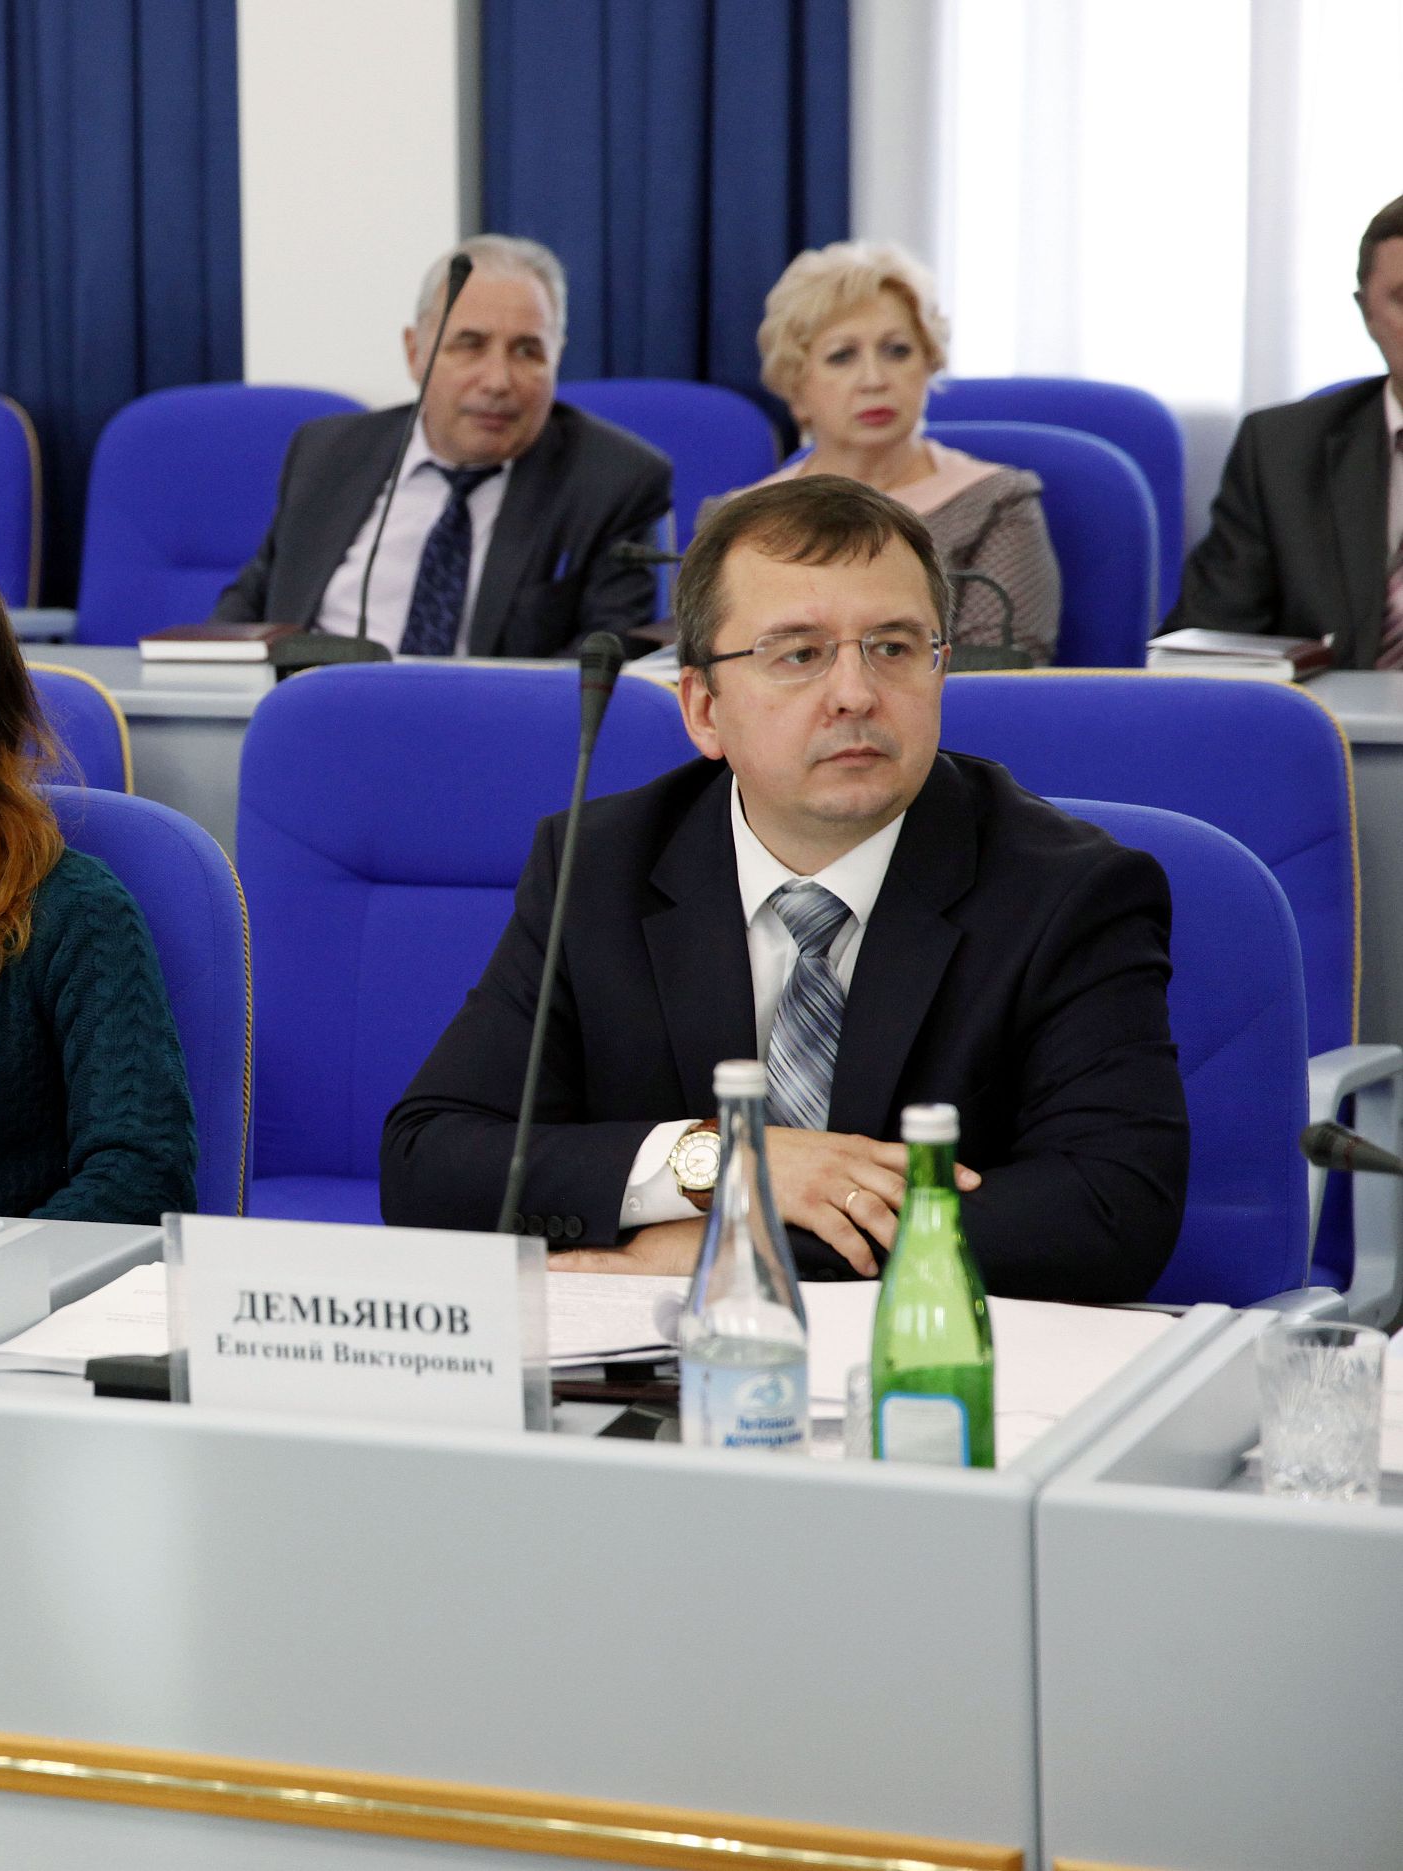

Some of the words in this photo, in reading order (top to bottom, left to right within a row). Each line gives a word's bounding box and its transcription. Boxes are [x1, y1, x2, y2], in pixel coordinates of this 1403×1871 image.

[233, 1290, 472, 1337] ДЕМЬЯНОВ
[216, 1333, 324, 1362] Евгений
[333, 1341, 495, 1377] Викторович
